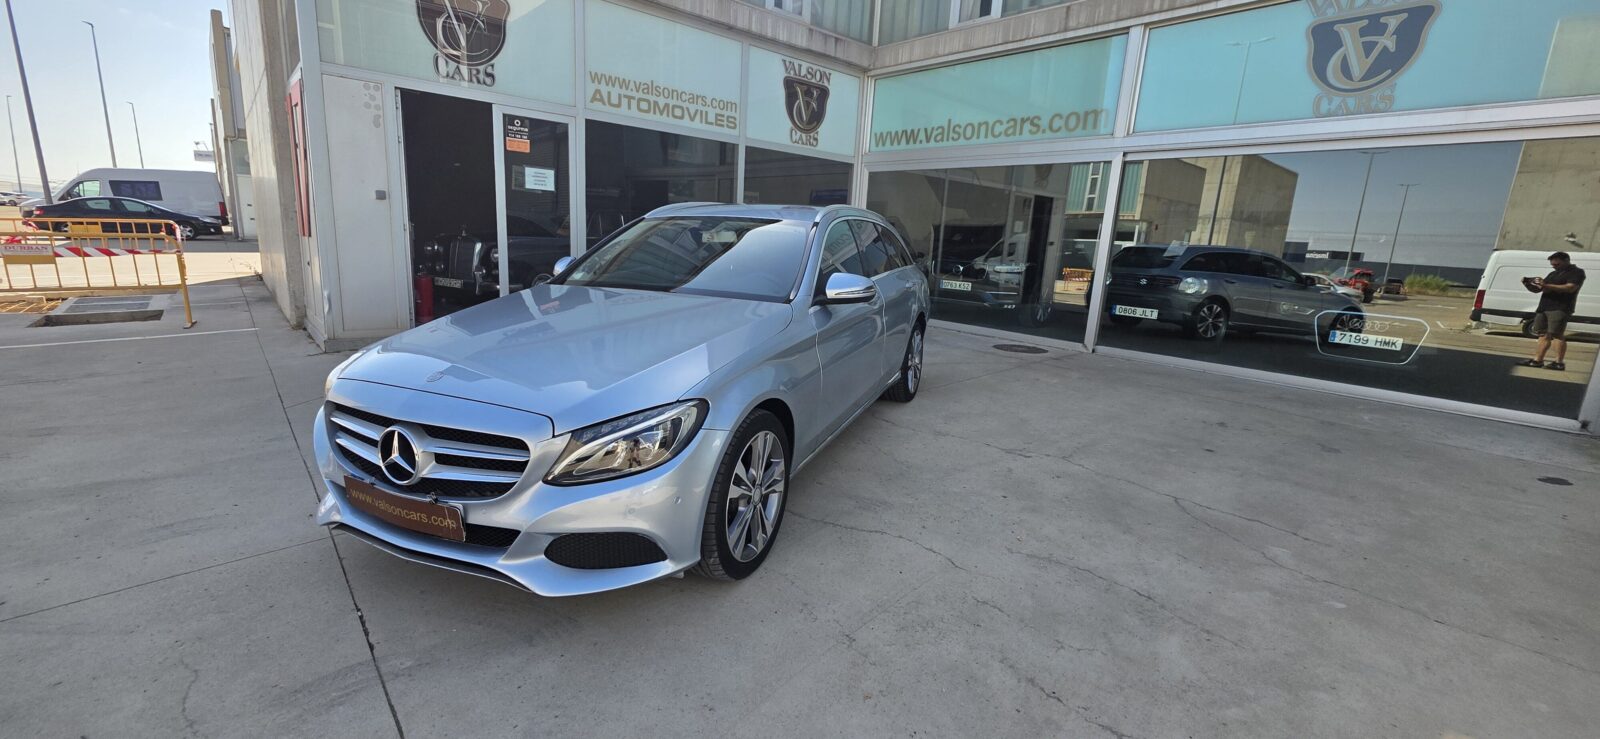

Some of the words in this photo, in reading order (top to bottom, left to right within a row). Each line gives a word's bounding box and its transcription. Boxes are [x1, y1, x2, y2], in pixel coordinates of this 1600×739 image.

[433, 53, 496, 87] CARS
[782, 59, 832, 86] VALSON
[589, 70, 738, 113] www.valsoncars.com
[1313, 87, 1395, 118] CARS
[590, 88, 738, 130] AUTOMOVILES
[790, 126, 819, 147] CARS
[873, 107, 1110, 148] www.valsoncars.com
[1118, 306, 1137, 316] 0806
[1139, 309, 1154, 318] JLT
[1339, 332, 1369, 345] 7199
[1374, 337, 1399, 349] HMK
[350, 488, 457, 530] www.valsoncars.com
